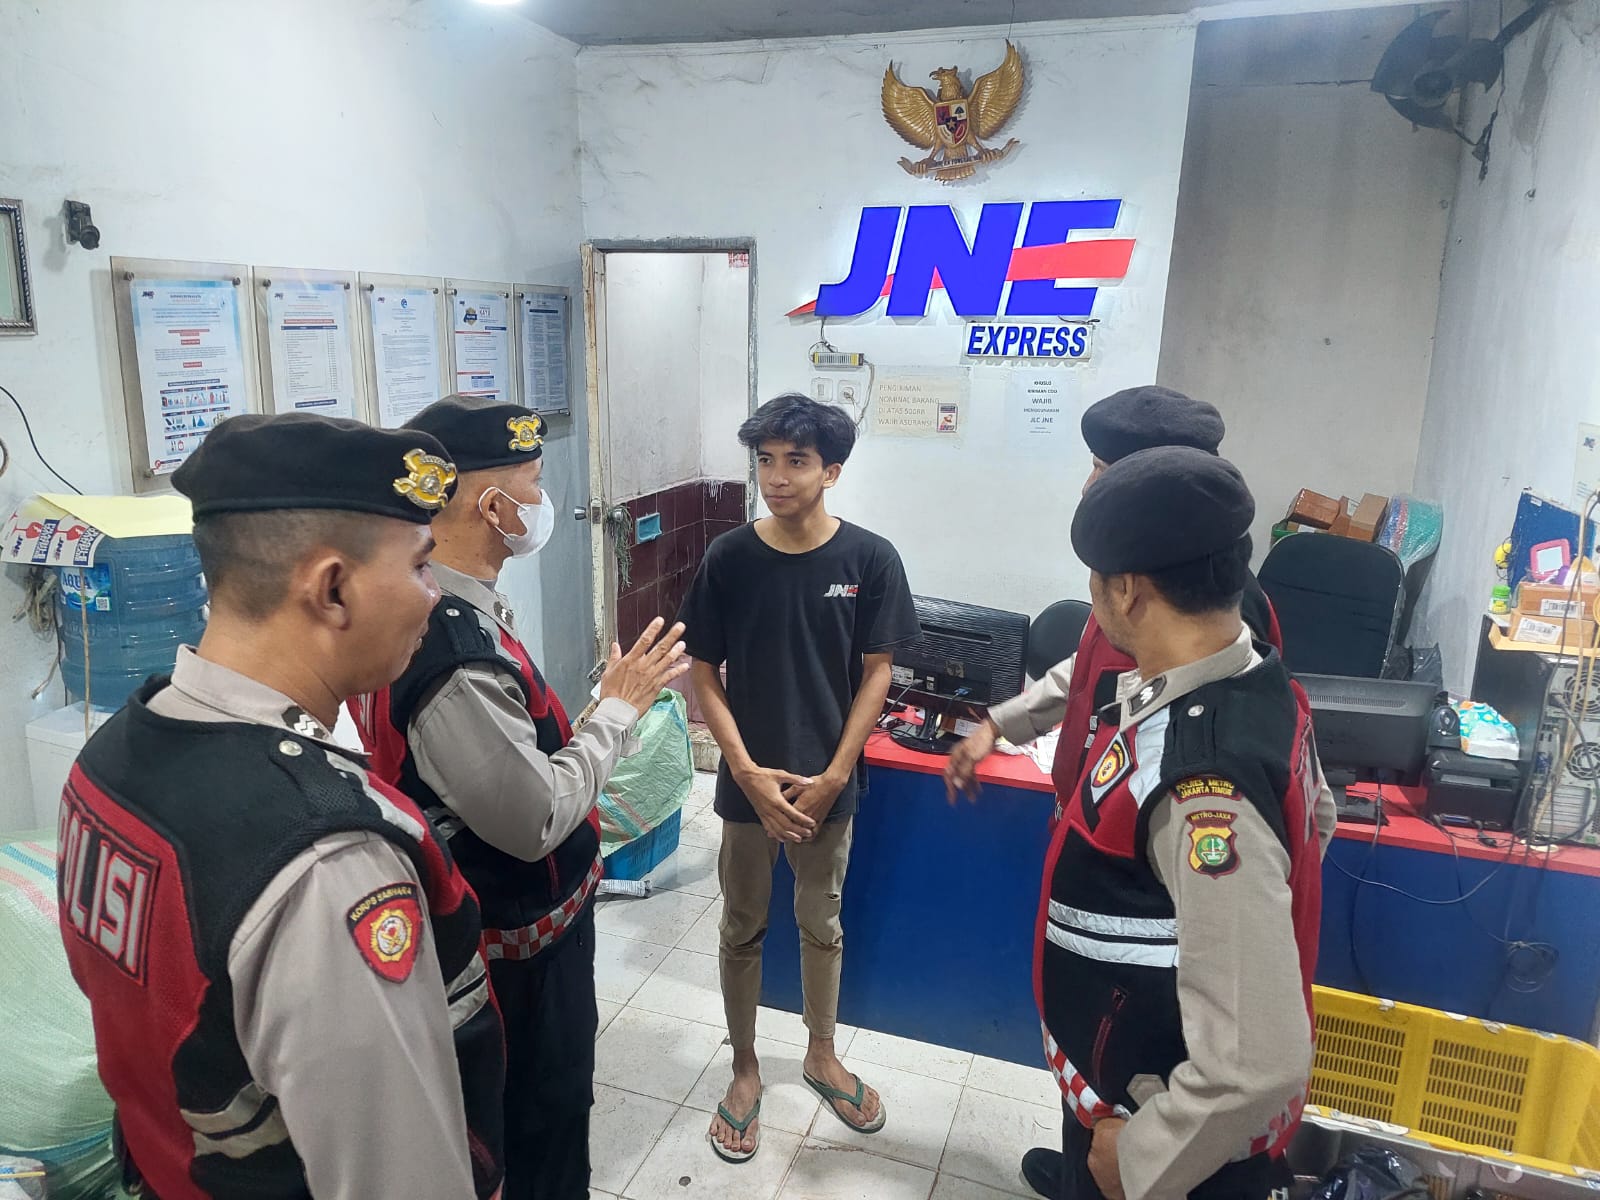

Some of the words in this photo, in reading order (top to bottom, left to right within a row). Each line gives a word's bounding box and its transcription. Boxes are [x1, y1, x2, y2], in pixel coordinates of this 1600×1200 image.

[814, 199, 1136, 316] JNE
[967, 325, 1087, 357] EXPRESS
[823, 584, 859, 598] JNE
[1181, 786, 1210, 799] JAKARTA
[1211, 786, 1234, 796] TIMUR
[349, 896, 378, 921] KORPS
